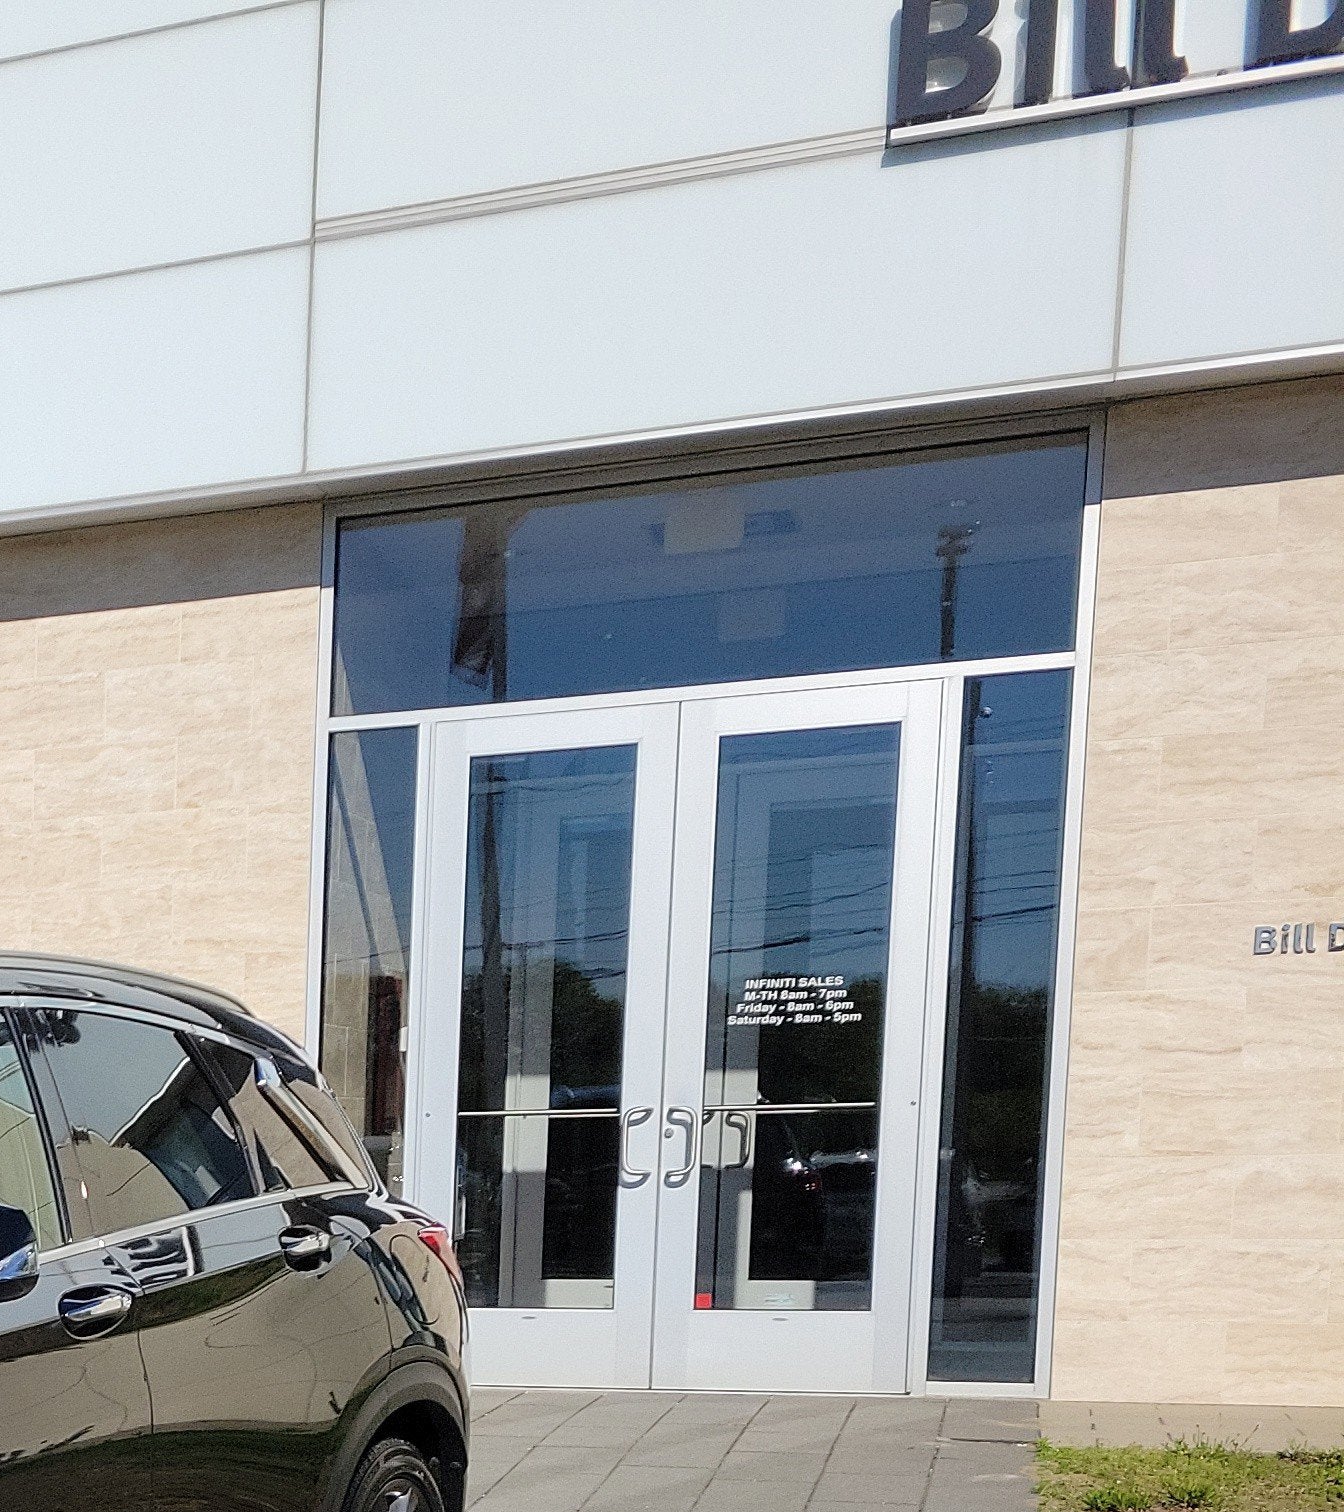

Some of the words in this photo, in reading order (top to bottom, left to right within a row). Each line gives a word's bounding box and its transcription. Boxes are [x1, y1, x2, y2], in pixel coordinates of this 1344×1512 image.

[1253, 922, 1316, 955] Bill
[745, 977, 796, 990] INFINITI
[798, 976, 844, 987] SALES
[744, 990, 778, 1001] M-TH
[780, 990, 808, 1000] 8am
[818, 989, 847, 1000] 7pm
[736, 1002, 777, 1014] Friday
[787, 1001, 814, 1012] 8am
[825, 1000, 854, 1012] 6pm
[727, 1014, 784, 1026] Saturday
[793, 1013, 823, 1023] 8am
[832, 1012, 862, 1024] 5pm
